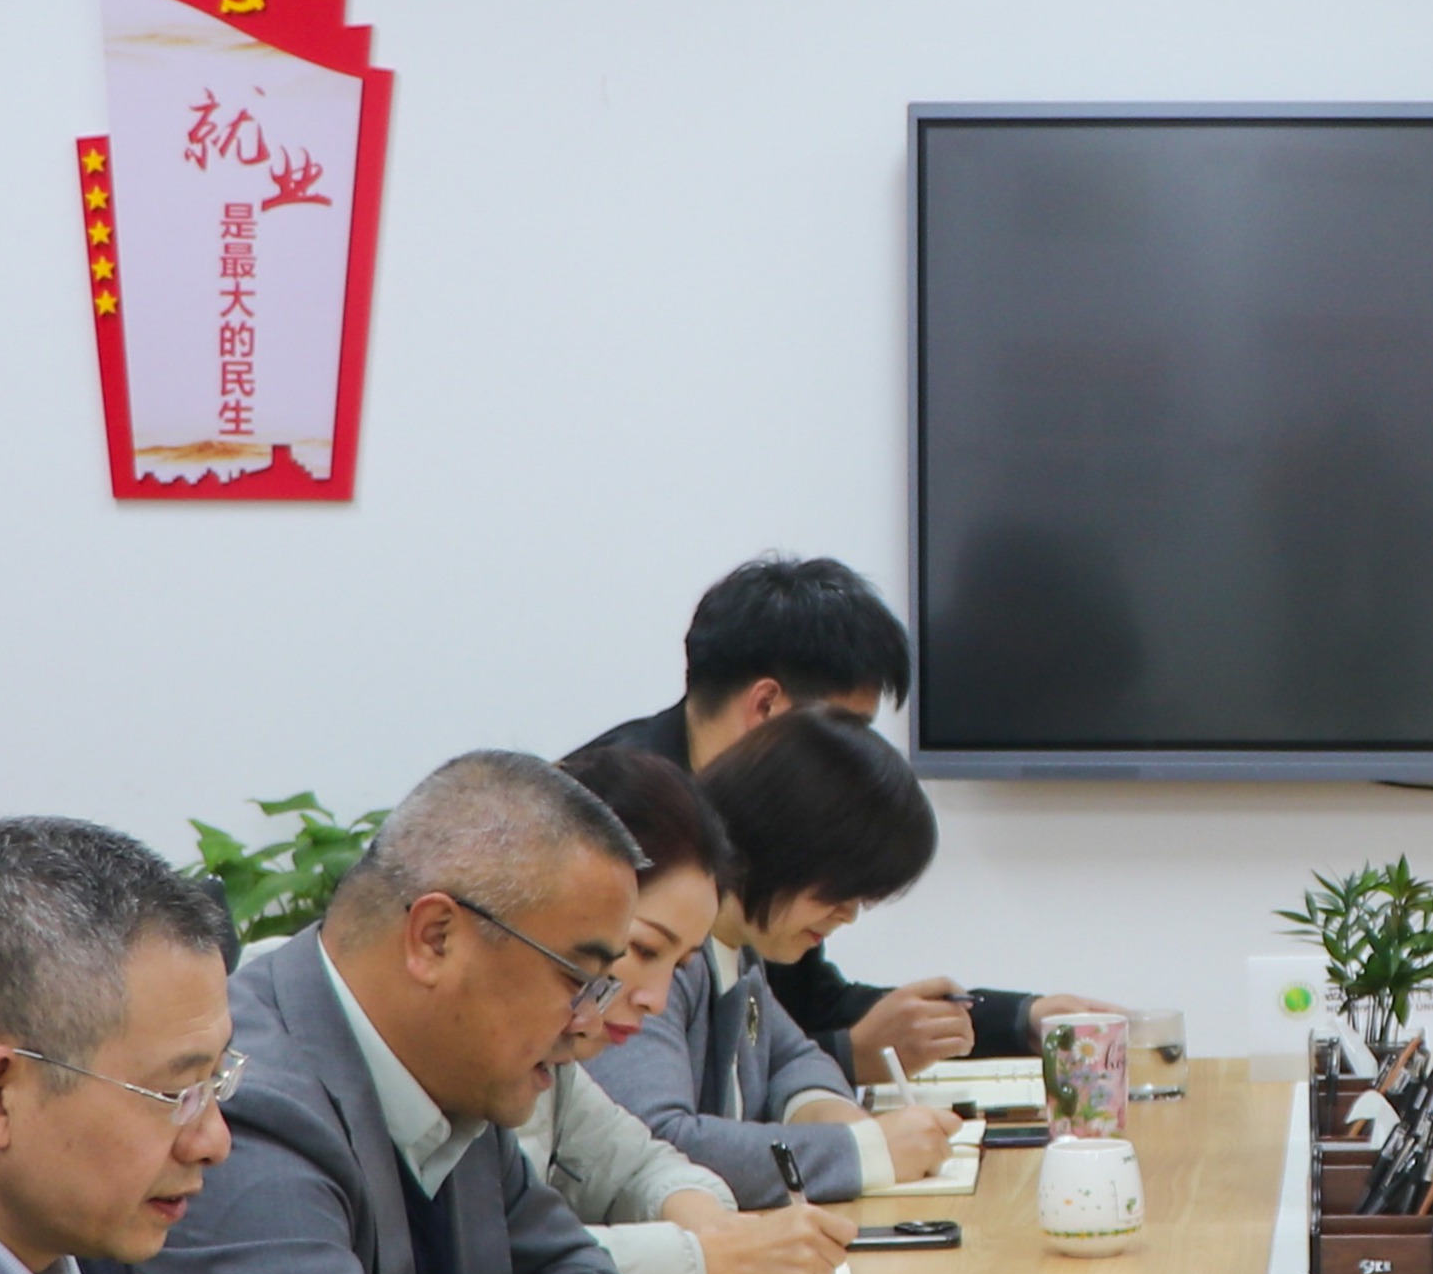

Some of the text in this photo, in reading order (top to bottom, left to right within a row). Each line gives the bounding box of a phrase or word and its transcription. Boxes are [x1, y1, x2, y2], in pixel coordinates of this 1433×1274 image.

[183, 86, 333, 212] 就业
[218, 204, 257, 437] 是最大的民生
